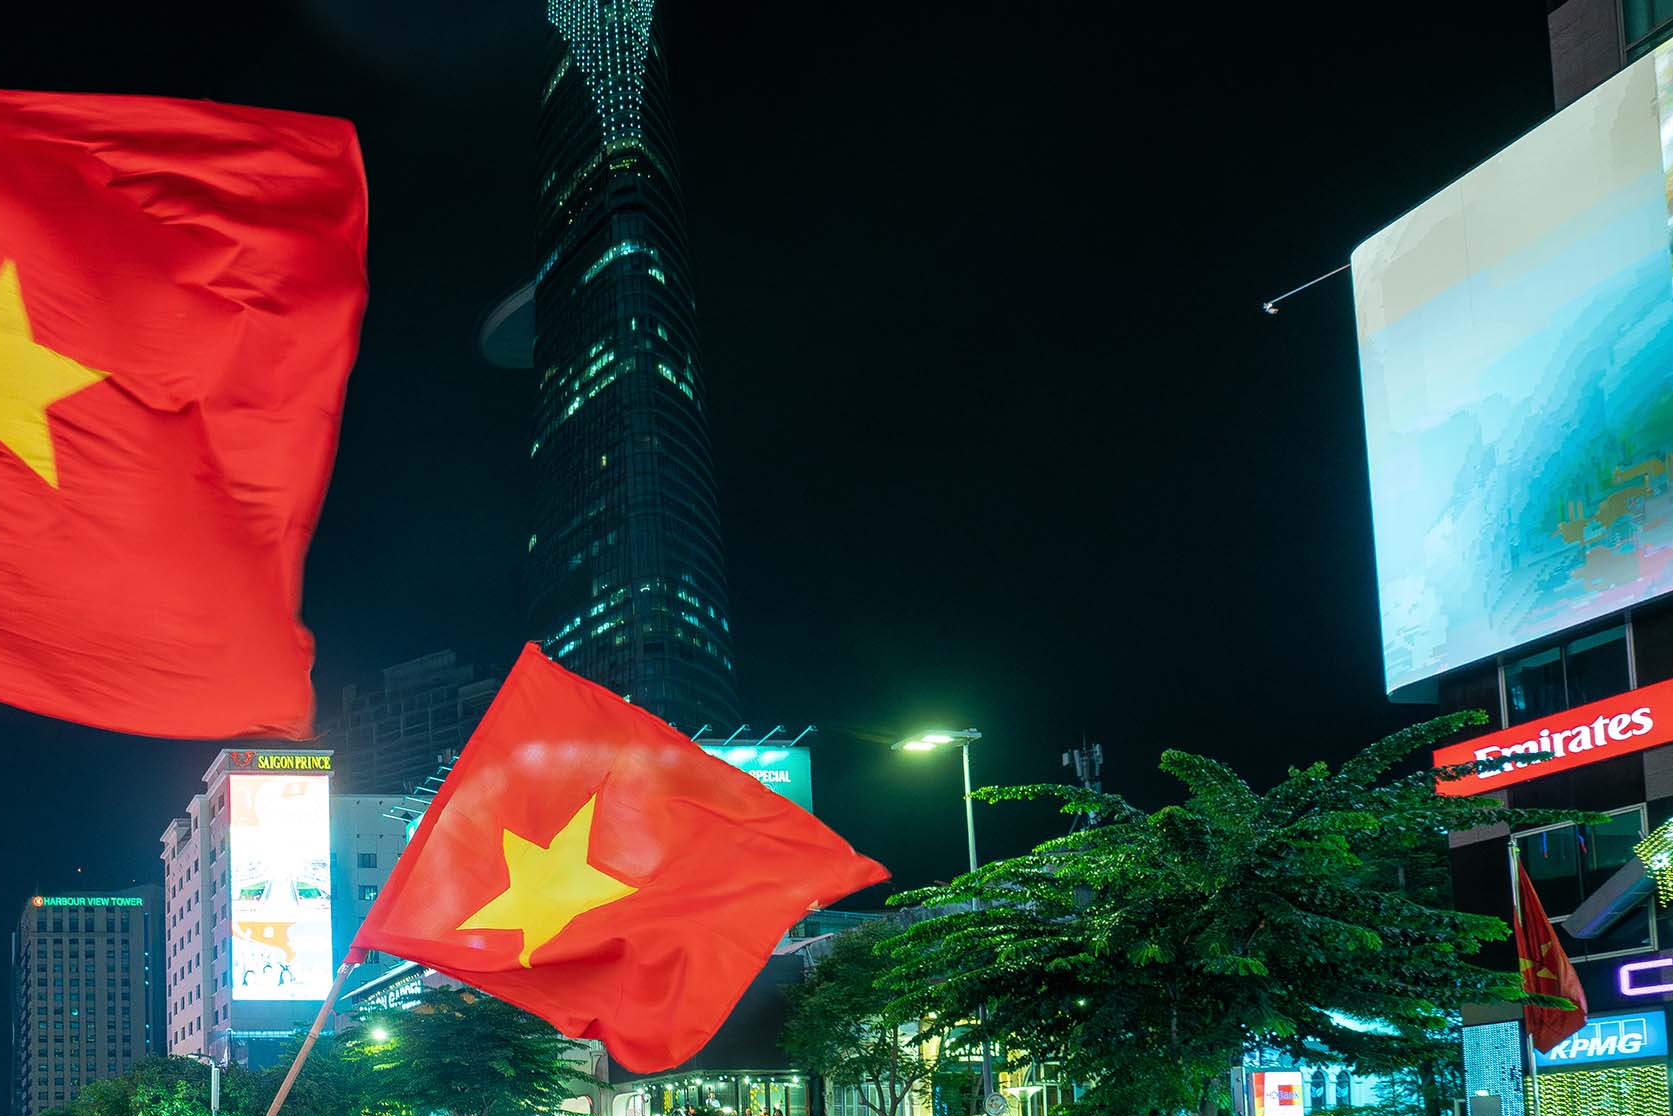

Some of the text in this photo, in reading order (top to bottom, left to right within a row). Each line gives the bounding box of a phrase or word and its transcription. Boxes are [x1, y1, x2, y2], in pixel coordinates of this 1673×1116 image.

[1475, 707, 1654, 779] Emirates
[258, 755, 331, 770] SAIGON PRINCE
[43, 896, 143, 907] HARBOUR VIEW TOWER
[1549, 1033, 1643, 1060] KPMG
